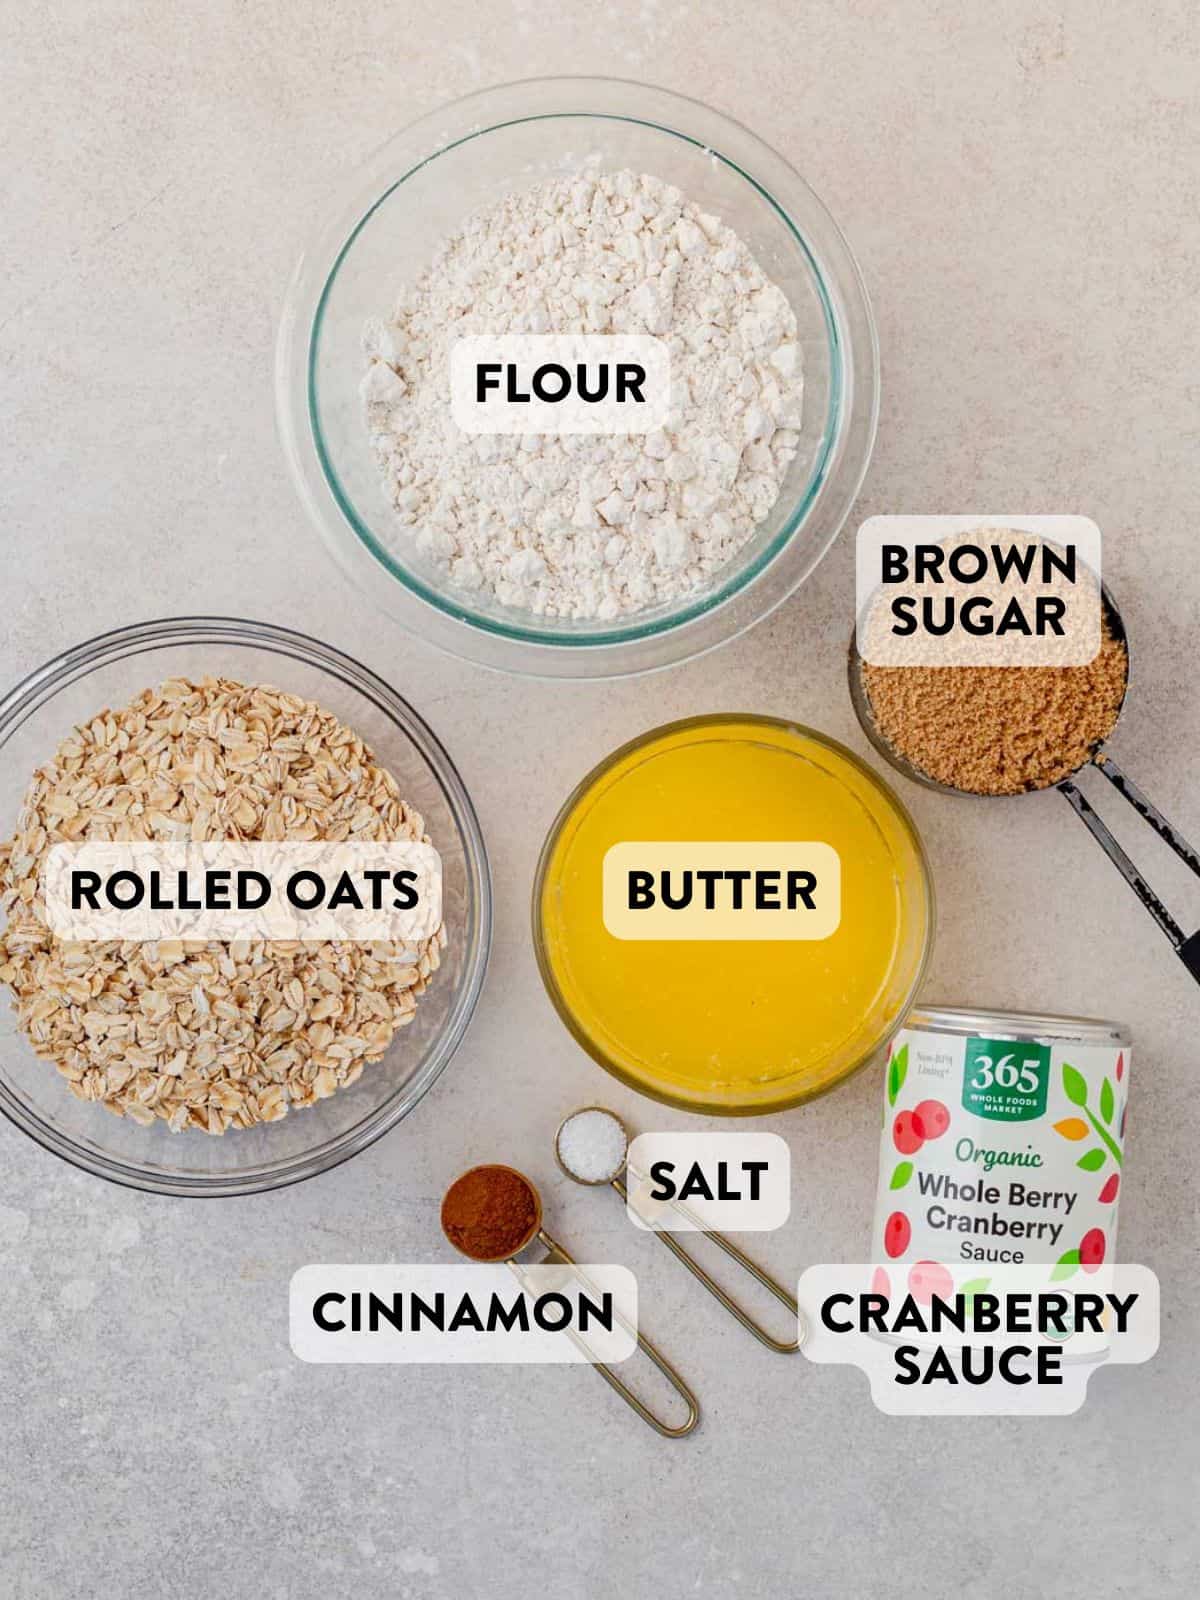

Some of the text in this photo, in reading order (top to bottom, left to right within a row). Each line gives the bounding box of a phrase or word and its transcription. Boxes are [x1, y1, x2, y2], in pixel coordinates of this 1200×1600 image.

[970, 1053, 1042, 1094] 365
[970, 1094, 1038, 1107] WHOLE FOODS
[984, 1105, 1023, 1115] MARKET
[955, 1138, 1043, 1172] Organic
[918, 1171, 1078, 1215] Whole Berry
[926, 1205, 1064, 1246] Cranberry
[960, 1241, 1024, 1265] Sauce
